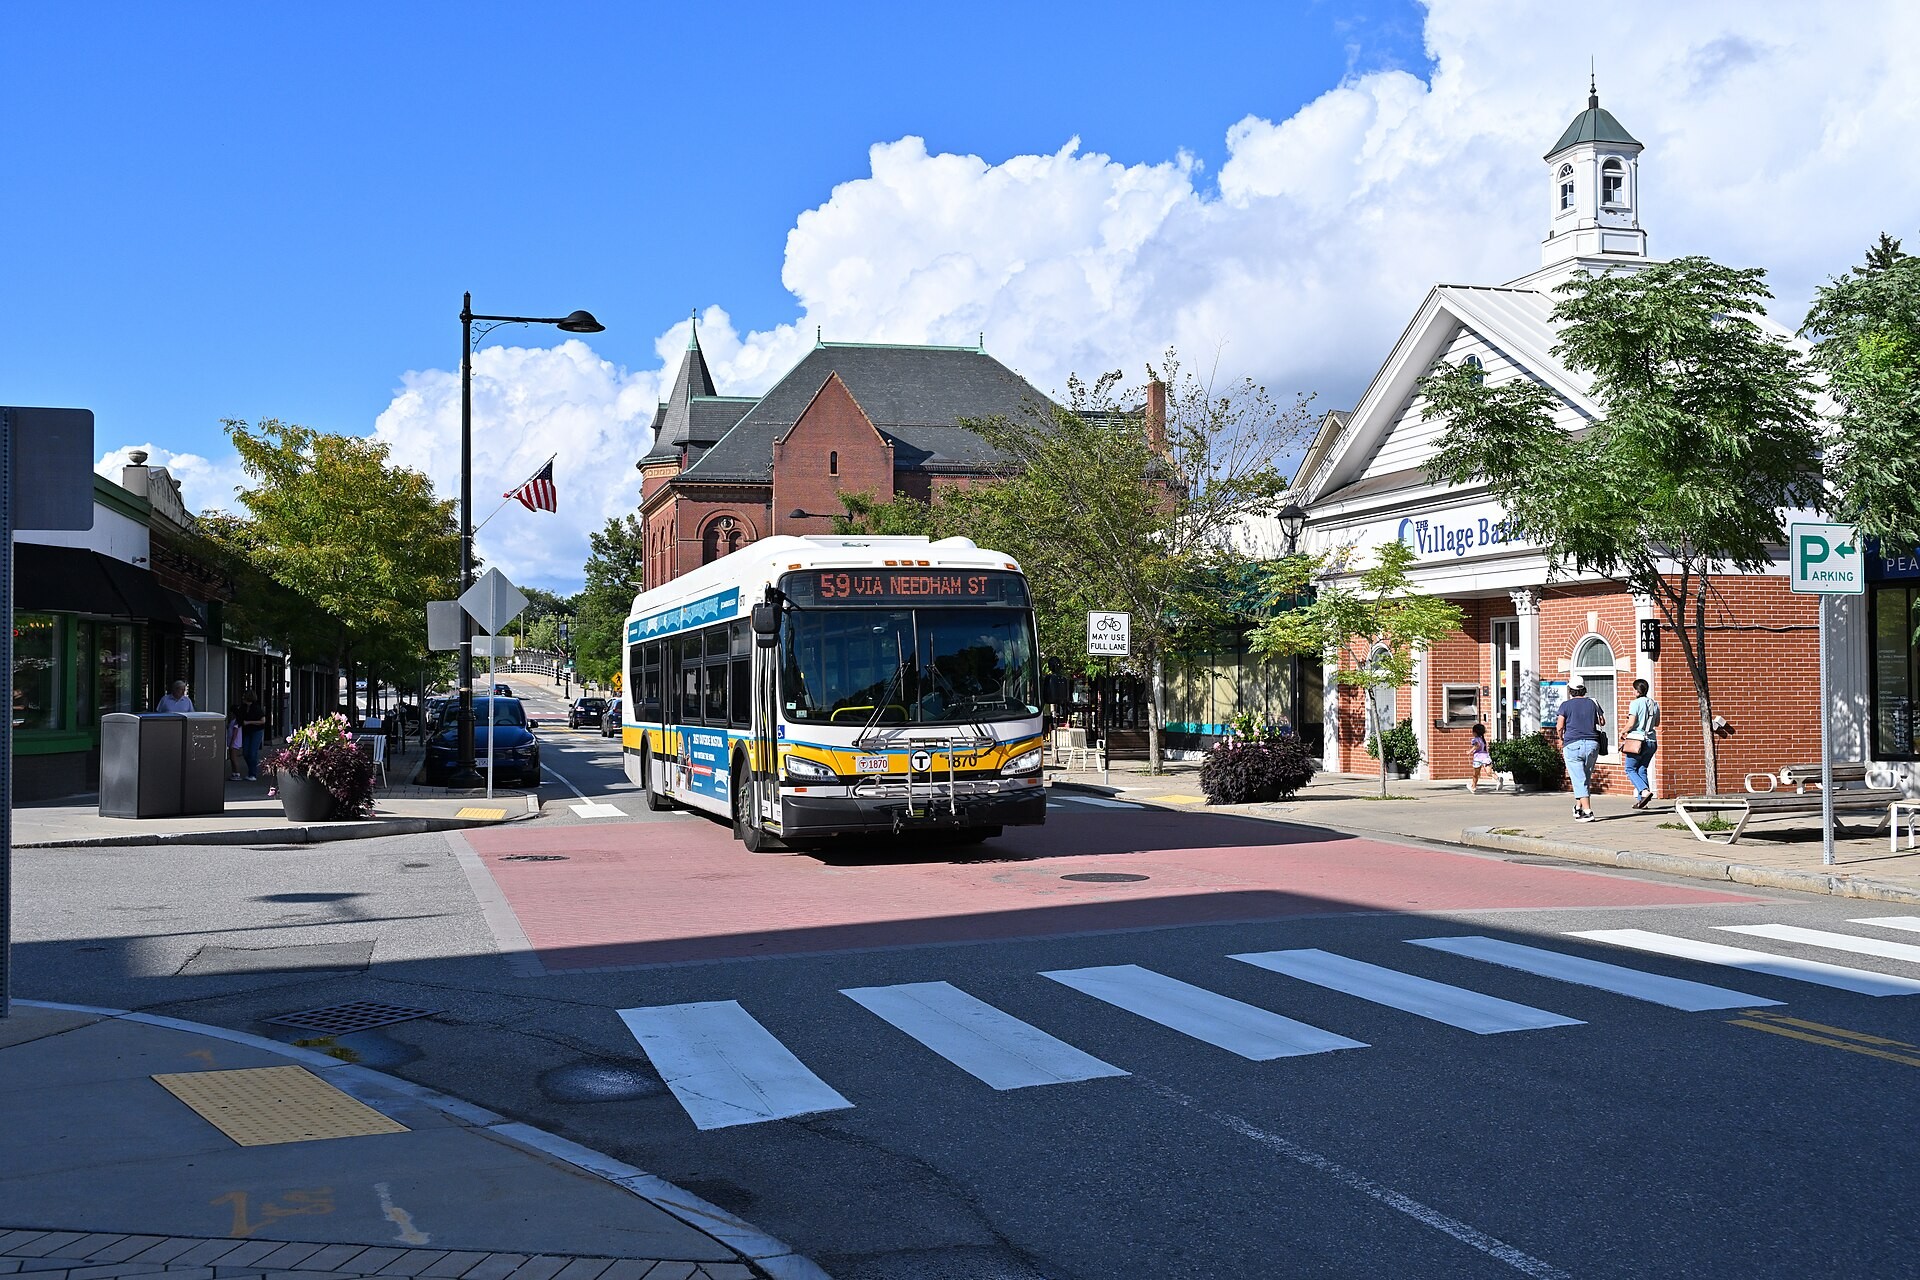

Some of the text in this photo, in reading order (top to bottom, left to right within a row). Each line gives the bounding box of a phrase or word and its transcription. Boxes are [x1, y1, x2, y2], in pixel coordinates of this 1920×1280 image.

[1415, 520, 1428, 528] THE
[1416, 525, 1473, 556] Village
[821, 574, 988, 597] 59 VIA NEEDHAM ST
[1109, 643, 1126, 651] LANE
[869, 760, 888, 769] 1870
